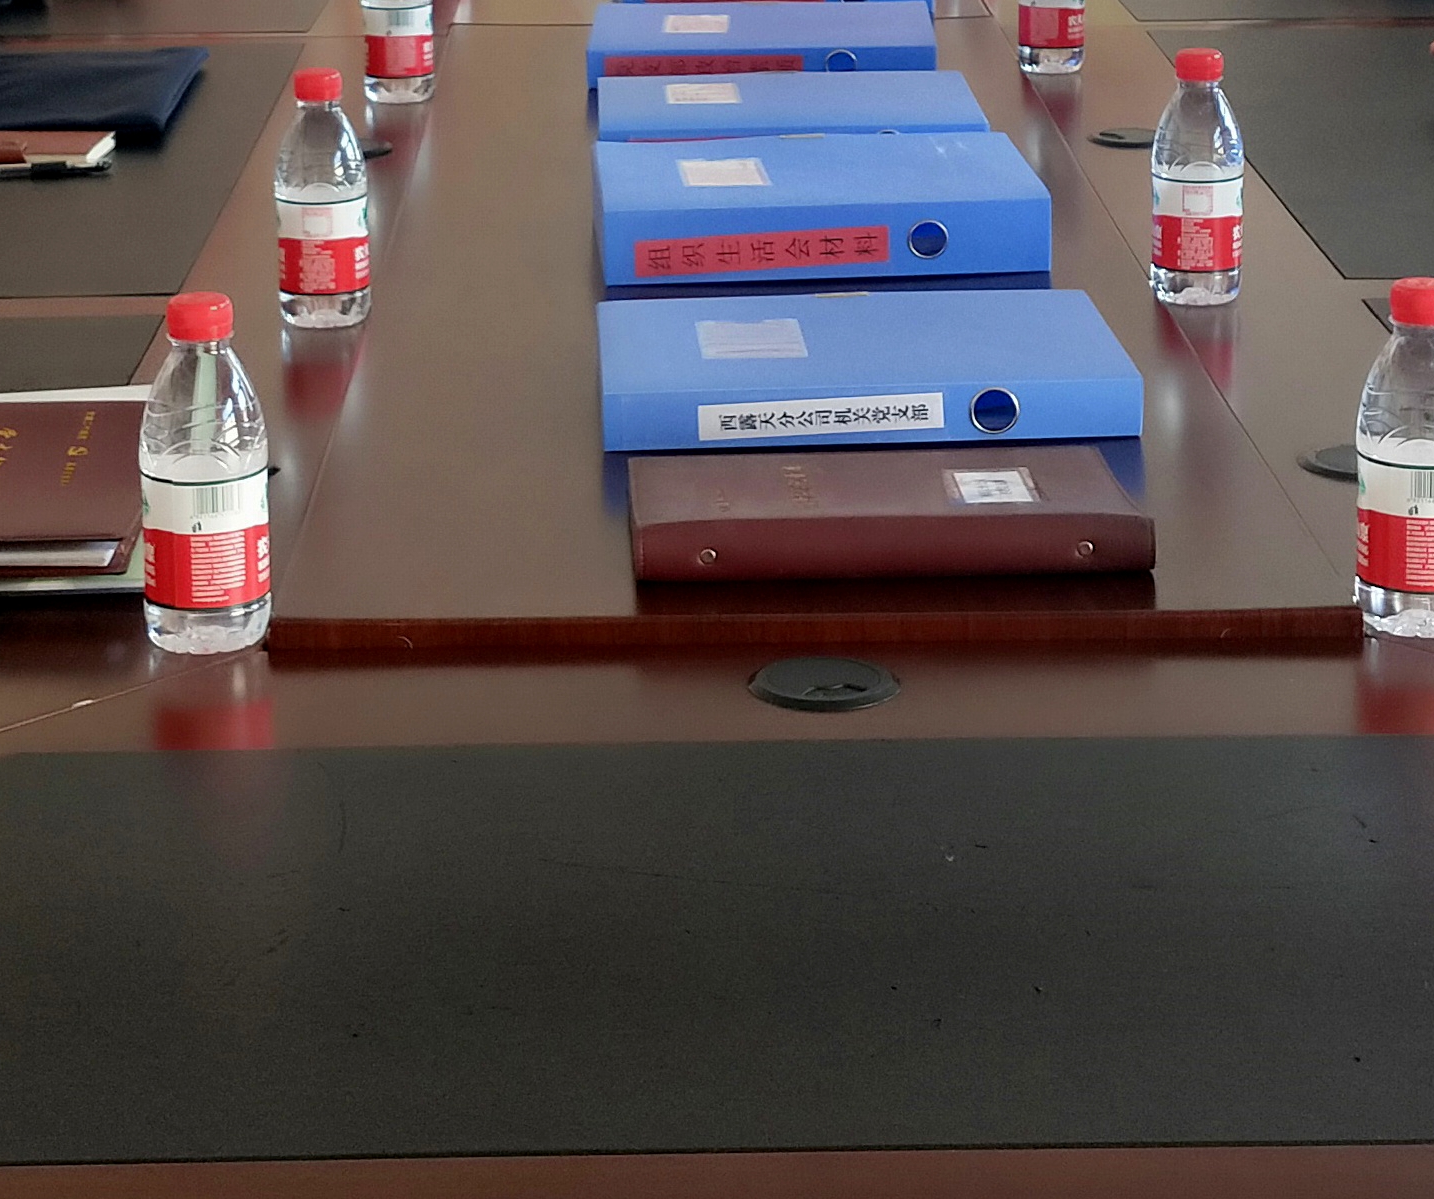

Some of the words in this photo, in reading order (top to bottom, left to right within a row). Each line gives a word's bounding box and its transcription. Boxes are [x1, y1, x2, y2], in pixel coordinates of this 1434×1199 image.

[647, 232, 879, 270] 组织生活会材料
[719, 403, 929, 432] 西露天分公司机关党支部
